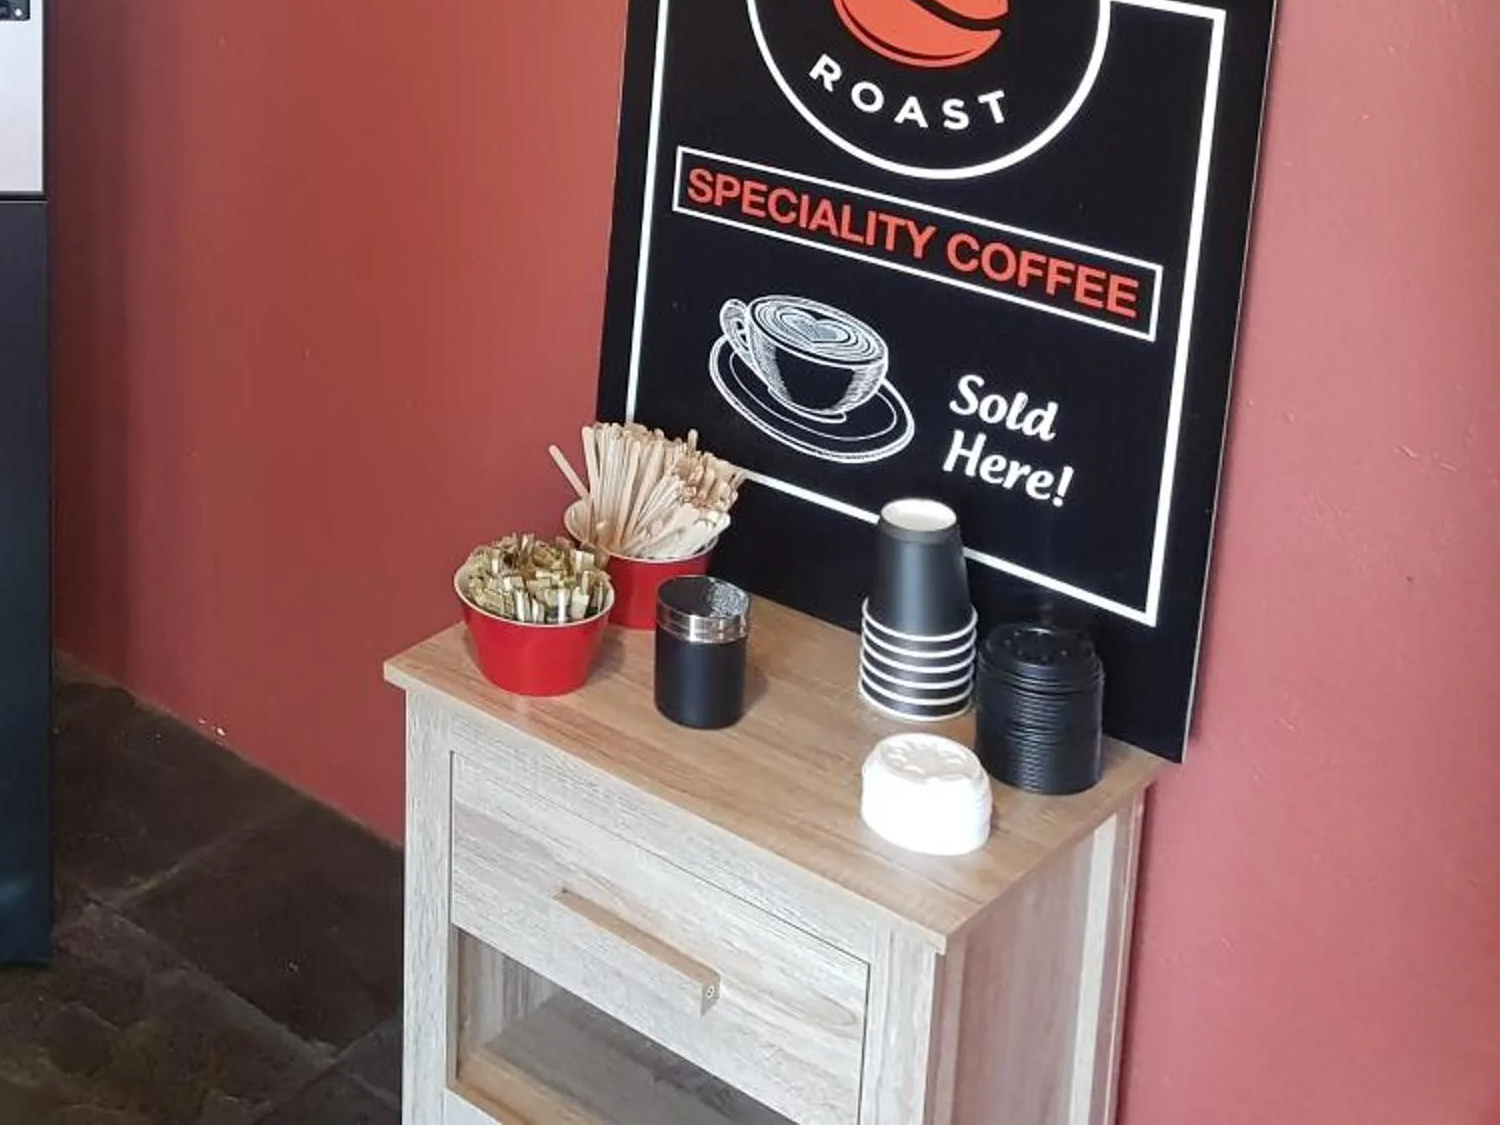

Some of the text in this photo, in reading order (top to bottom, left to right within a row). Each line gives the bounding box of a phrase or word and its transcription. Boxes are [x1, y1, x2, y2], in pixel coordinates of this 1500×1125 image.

[808, 54, 1006, 131] ROAST
[687, 169, 1140, 320] SPECIALITY COFFEE
[949, 374, 1058, 442] Sold
[941, 429, 1075, 508] Here!
